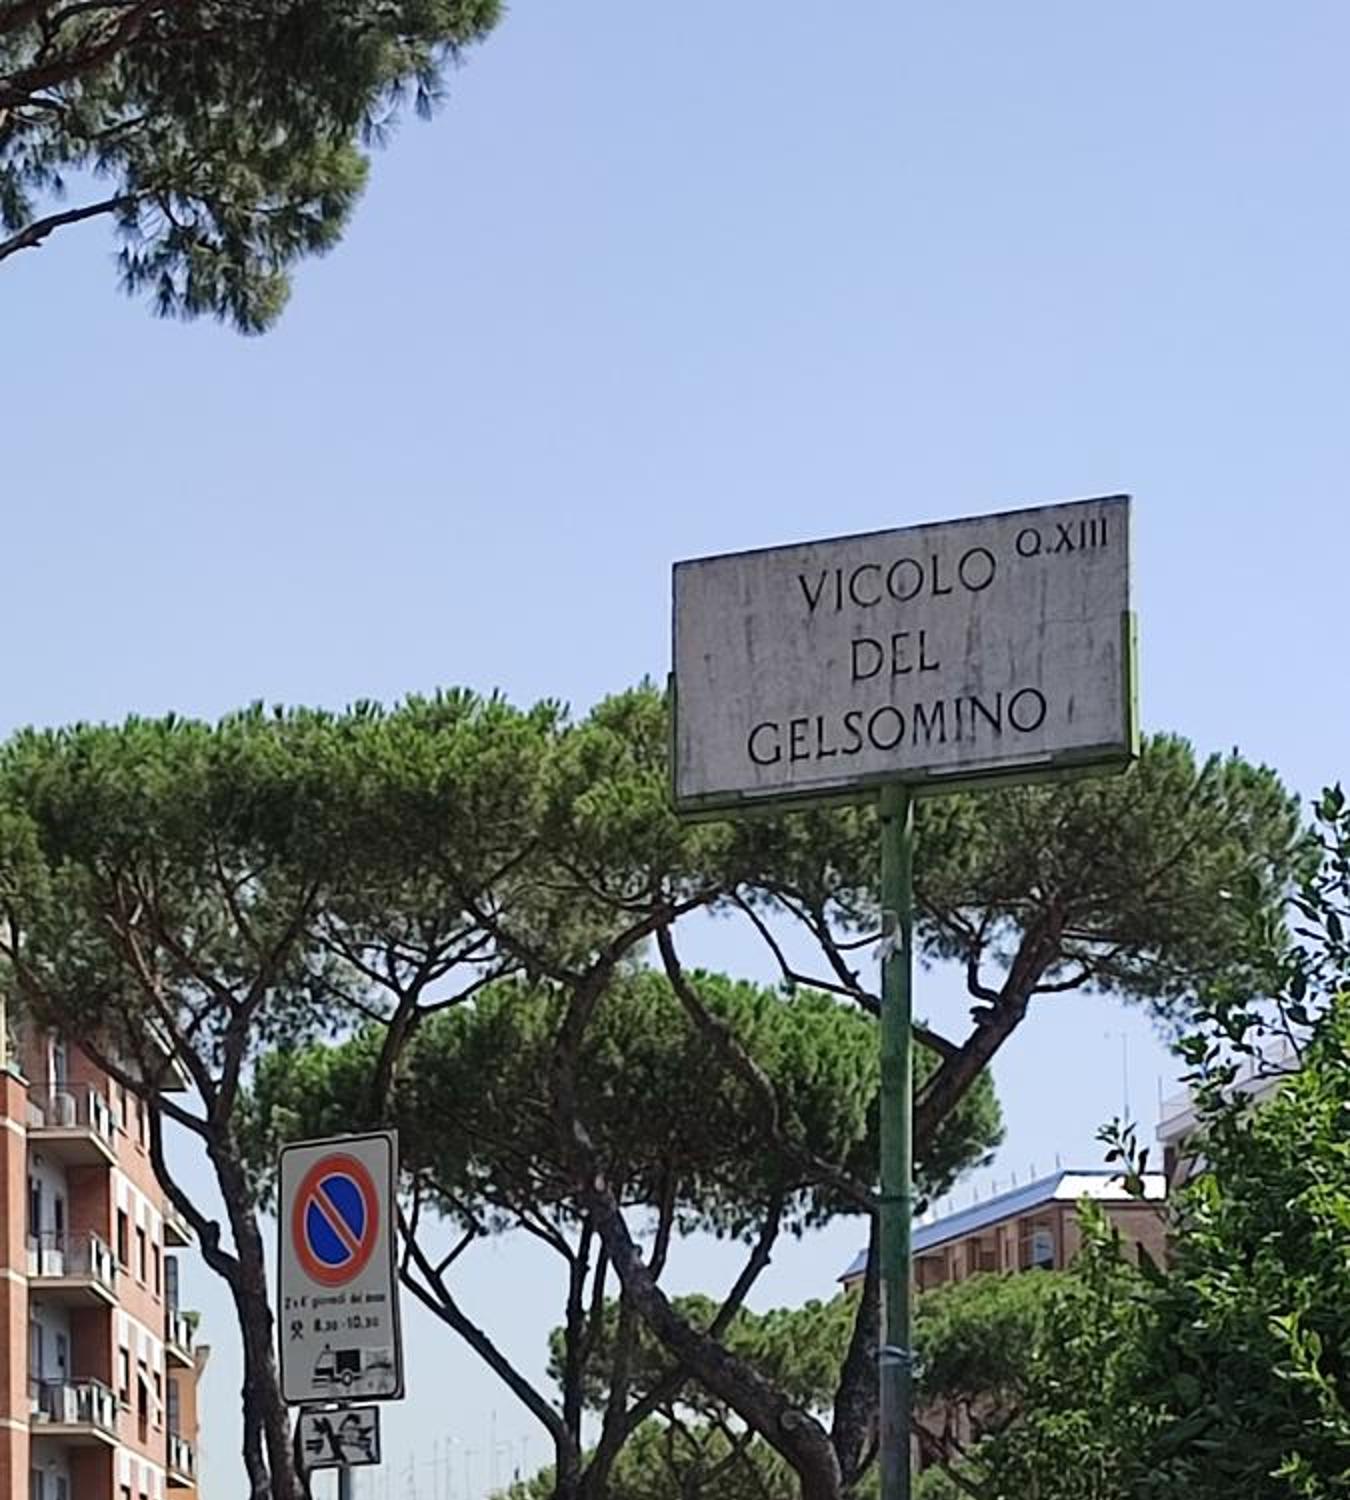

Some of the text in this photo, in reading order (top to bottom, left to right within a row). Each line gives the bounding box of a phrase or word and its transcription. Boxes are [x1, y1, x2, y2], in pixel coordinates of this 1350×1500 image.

[1016, 517, 1107, 557] Q.XIII
[798, 547, 996, 613] VICOLO
[850, 630, 940, 682] DEL
[747, 688, 1048, 766] GELSOMINO
